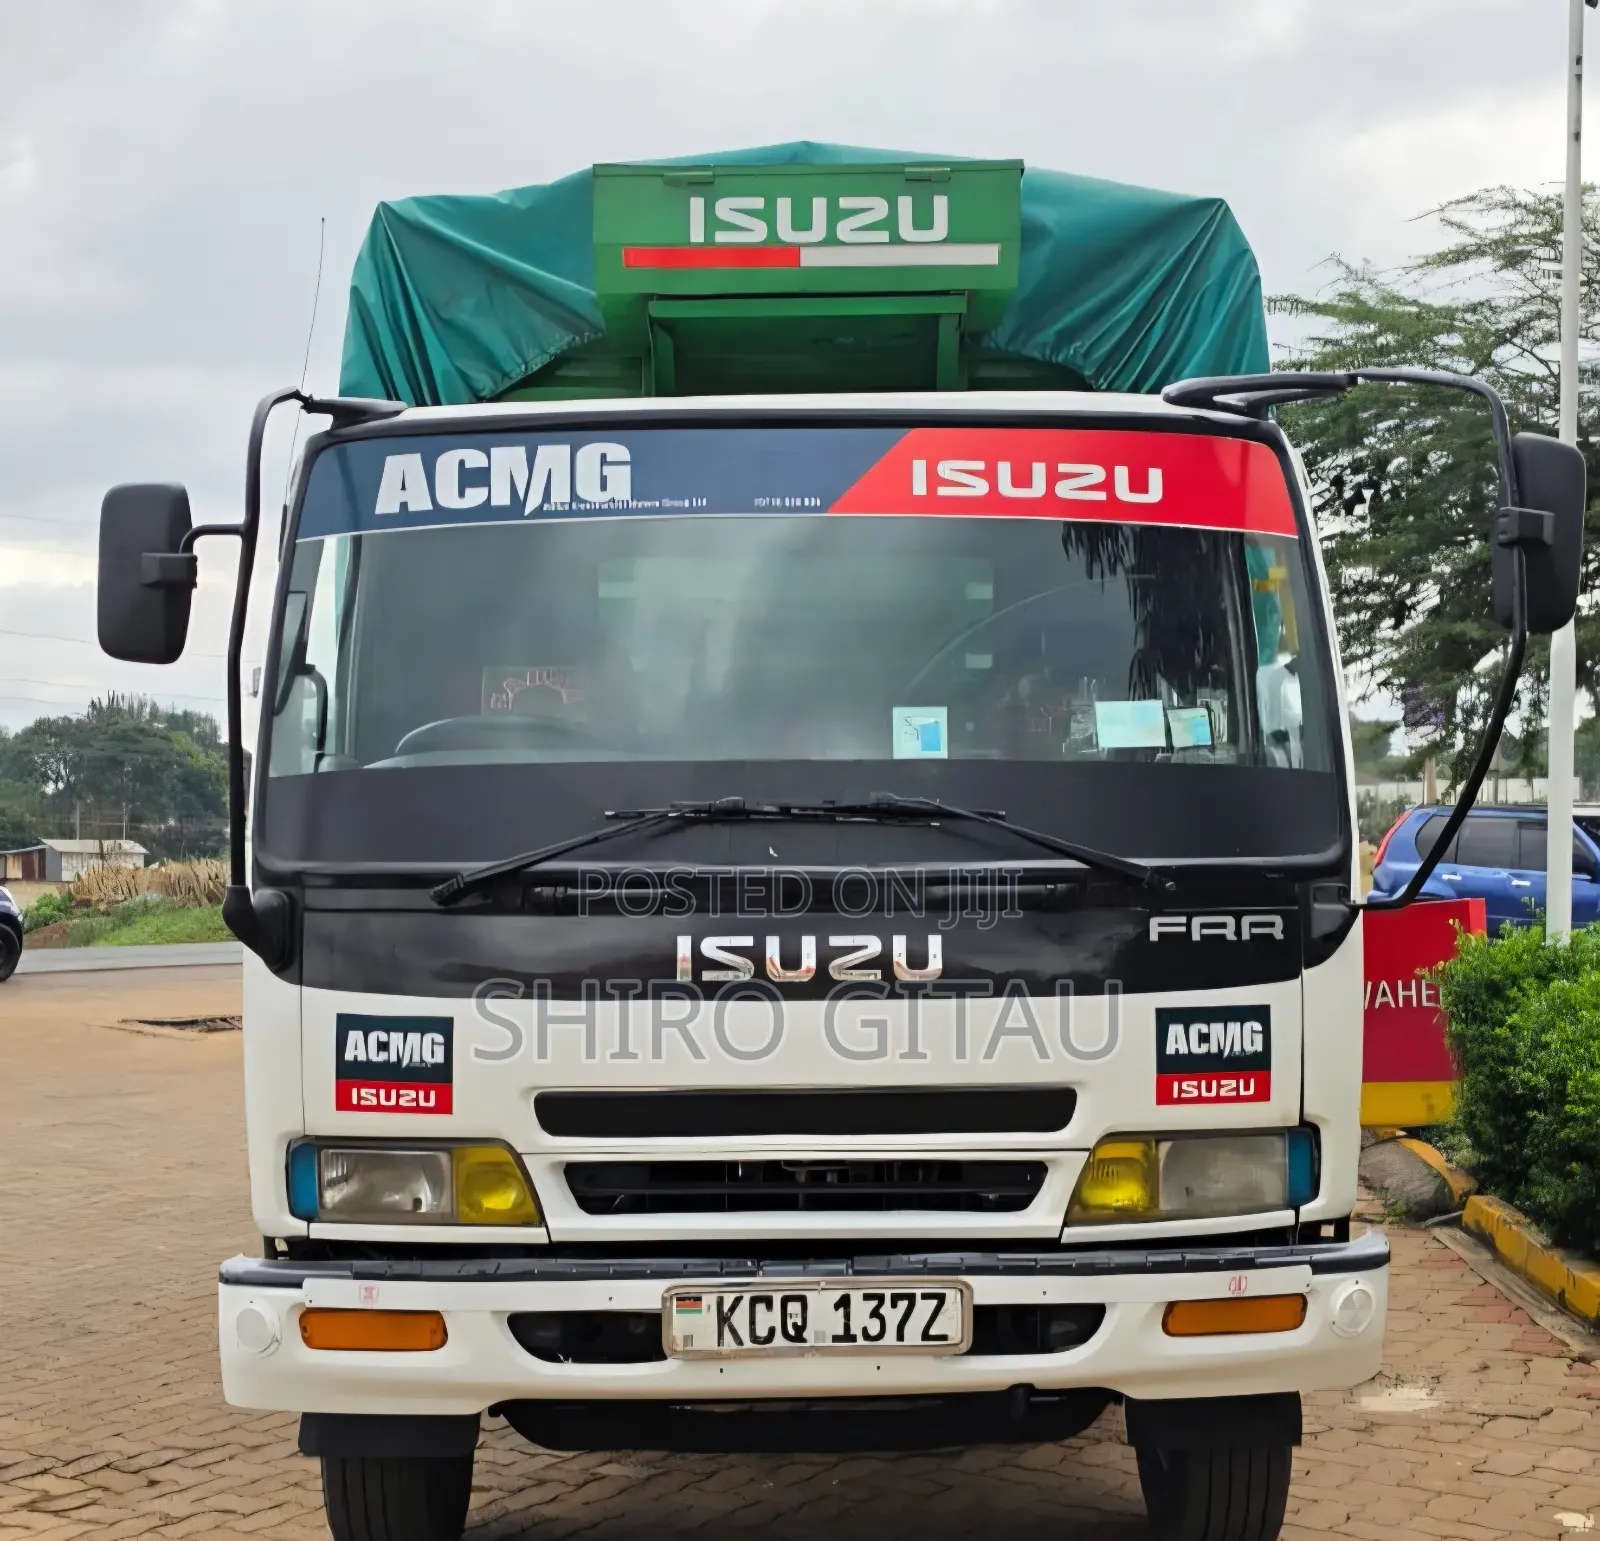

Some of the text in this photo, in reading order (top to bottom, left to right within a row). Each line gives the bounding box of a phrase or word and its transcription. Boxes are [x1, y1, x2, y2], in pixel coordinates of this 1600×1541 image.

[689, 195, 949, 244] ISUZU
[375, 442, 631, 517] ACMG
[912, 459, 1163, 504] ISUZU
[1149, 914, 1285, 942] FRR
[676, 934, 943, 982] ISUZU
[344, 1029, 445, 1068] ACMG
[1165, 1020, 1263, 1059] ACMG
[351, 1087, 436, 1107] ISUZU
[1172, 1078, 1255, 1099] ISUZU
[716, 1292, 949, 1347] KCQ 137Z
